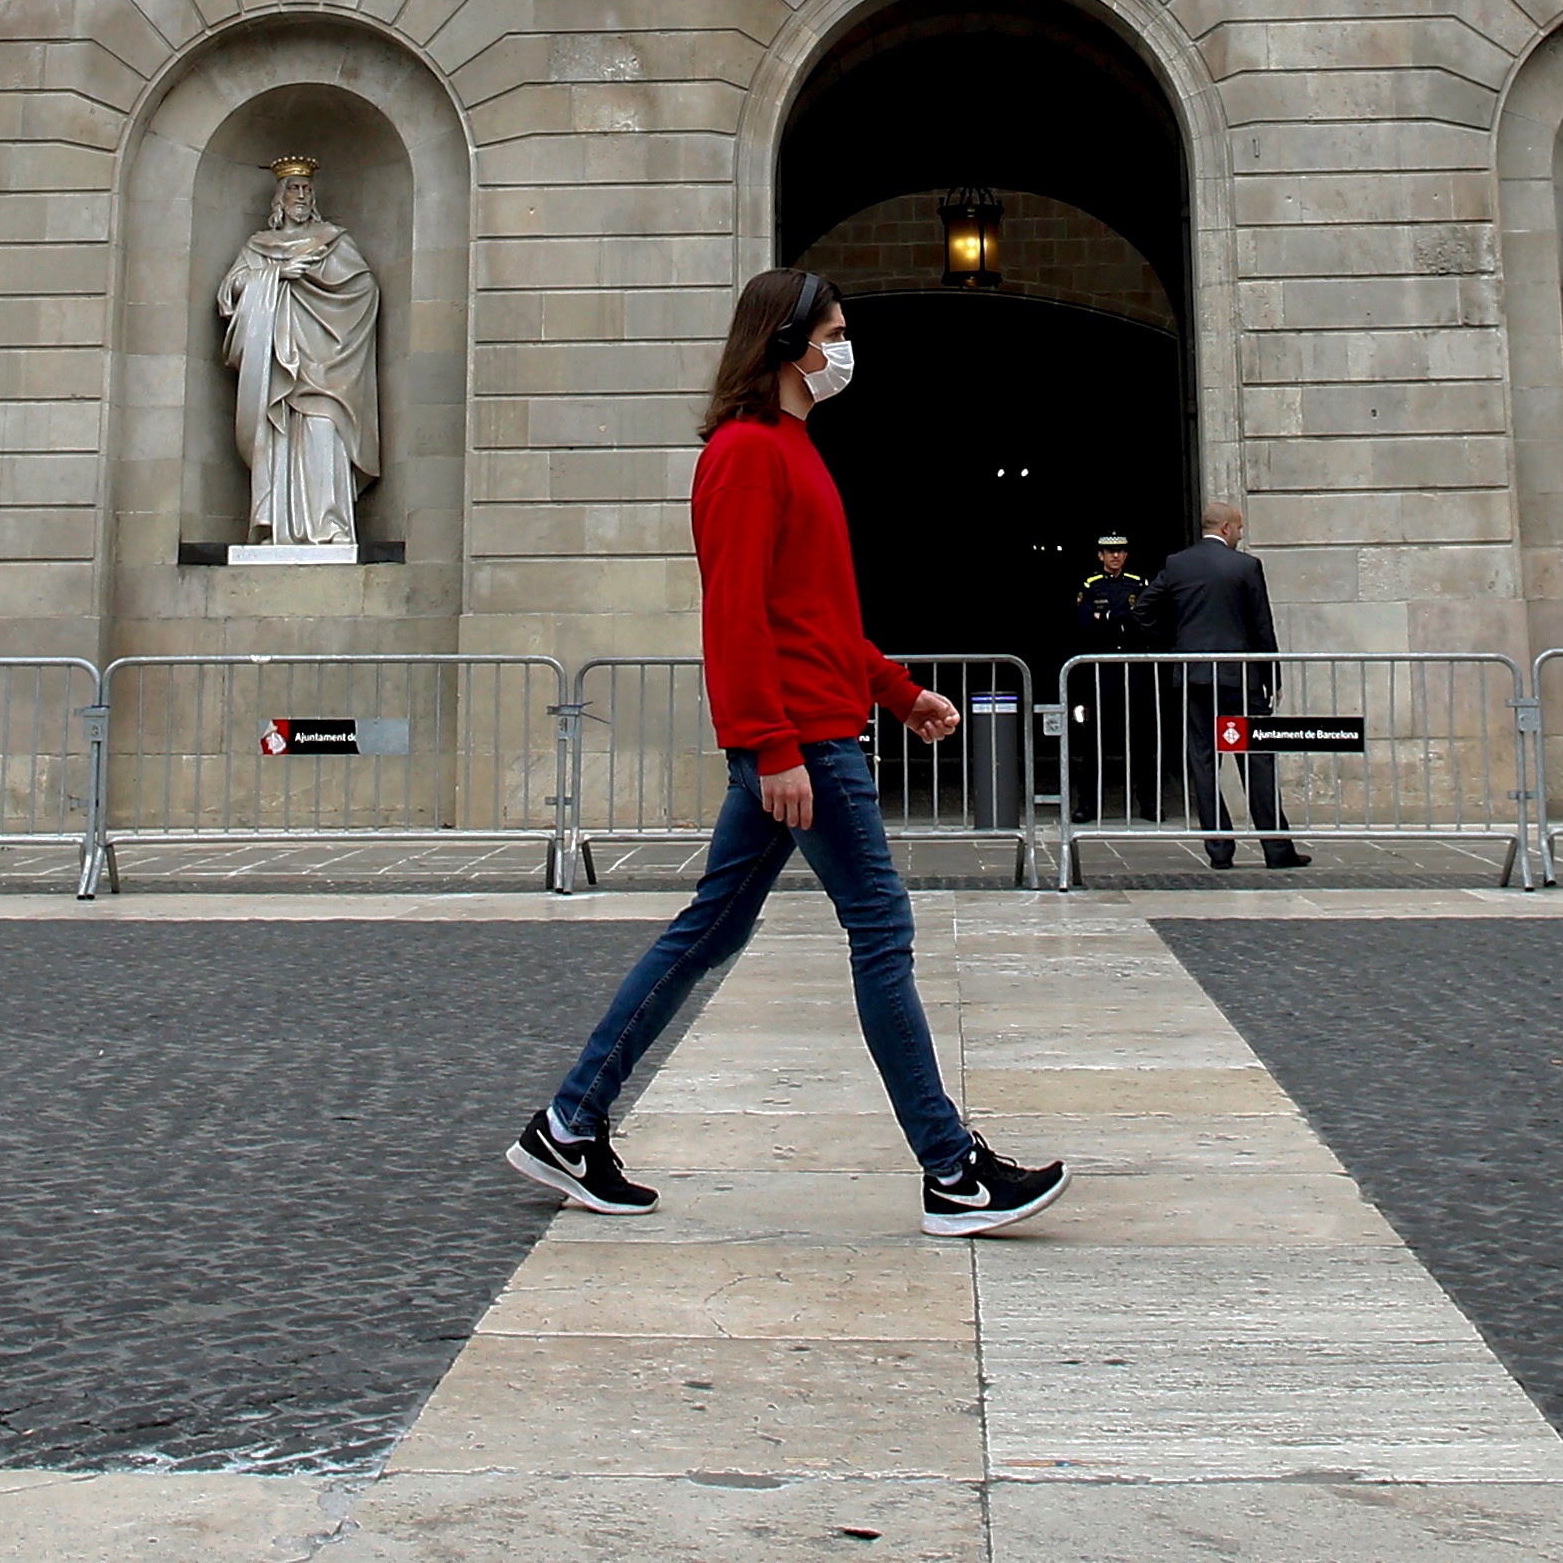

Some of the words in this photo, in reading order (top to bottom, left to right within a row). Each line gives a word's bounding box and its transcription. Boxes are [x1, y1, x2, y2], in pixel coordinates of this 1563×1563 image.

[294, 732, 346, 743] Ajuntament
[1252, 729, 1304, 740] Ajuntament
[1305, 729, 1315, 739] de
[1317, 729, 1359, 739] Barcelona
